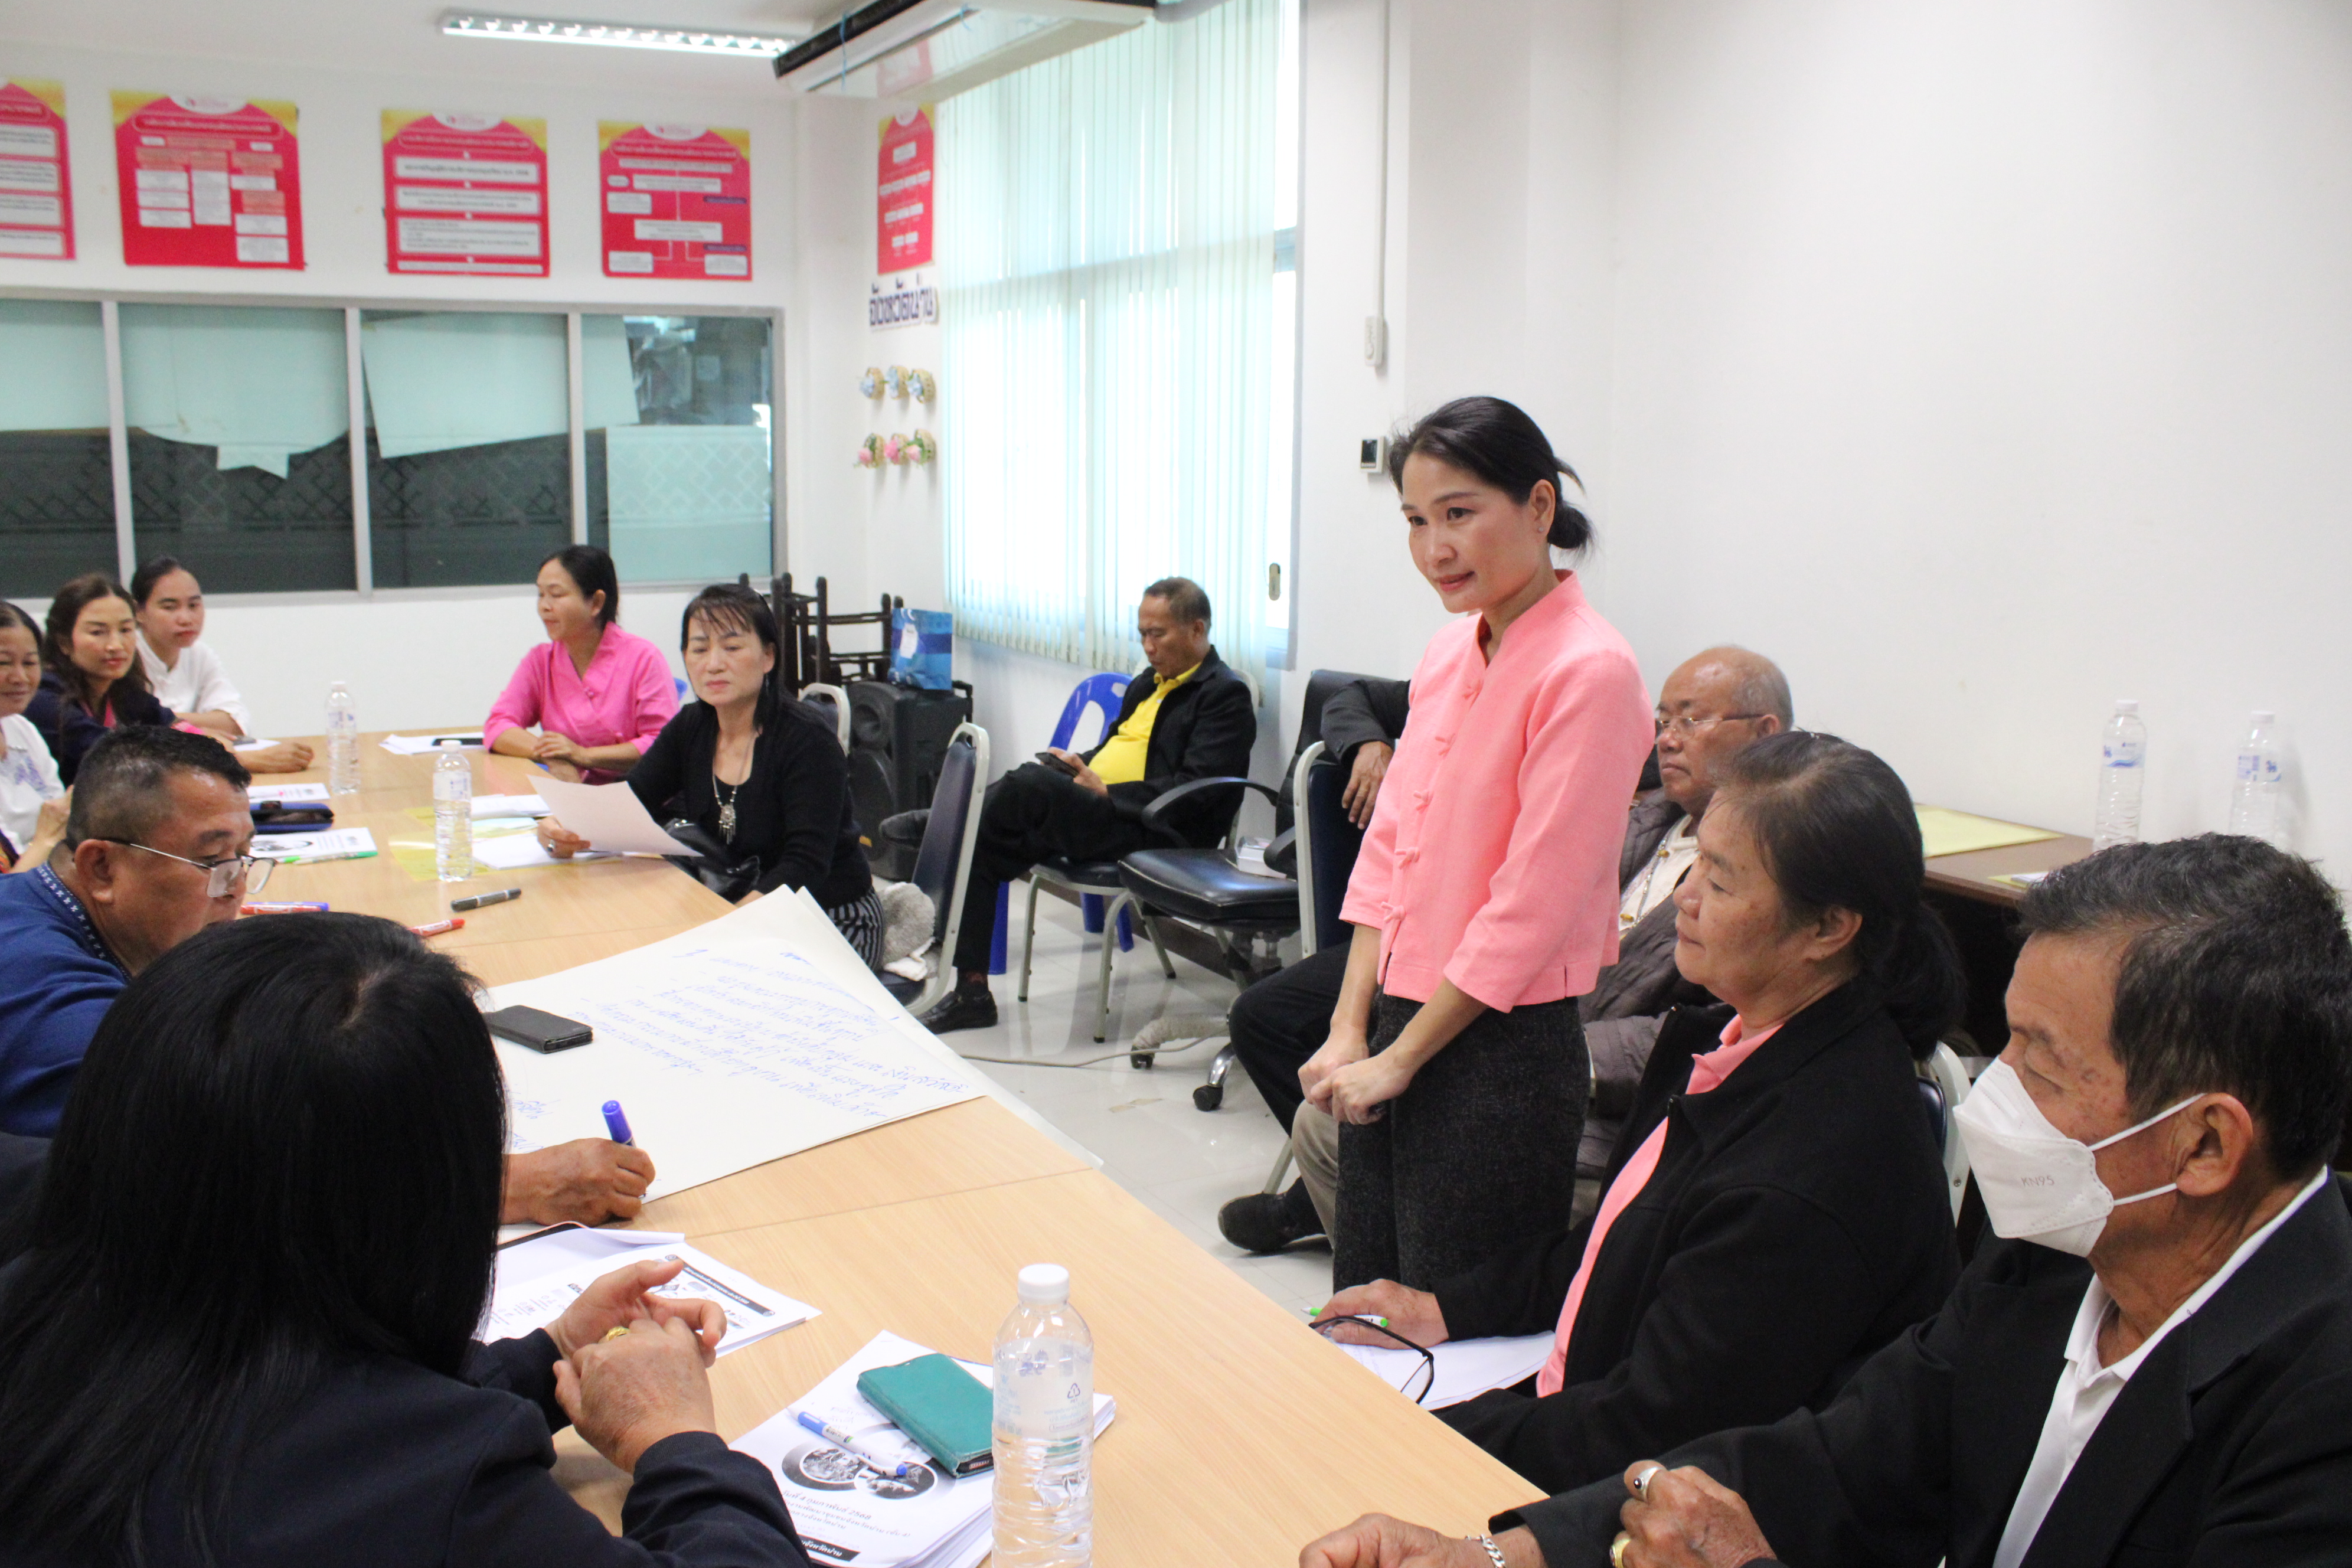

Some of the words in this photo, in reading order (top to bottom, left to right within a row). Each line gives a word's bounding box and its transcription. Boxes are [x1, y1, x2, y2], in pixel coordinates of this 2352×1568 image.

[870, 273, 933, 326] จังหวัดน่าน
[2020, 1175, 2055, 1187] KN95
[782, 1489, 803, 1498] วันที่
[806, 1498, 849, 1513] กุมภาพันธ์
[848, 1508, 872, 1520] 2568
[785, 1500, 885, 1534] กงานพัฒนาชุมชนจังหวัดน่าน
